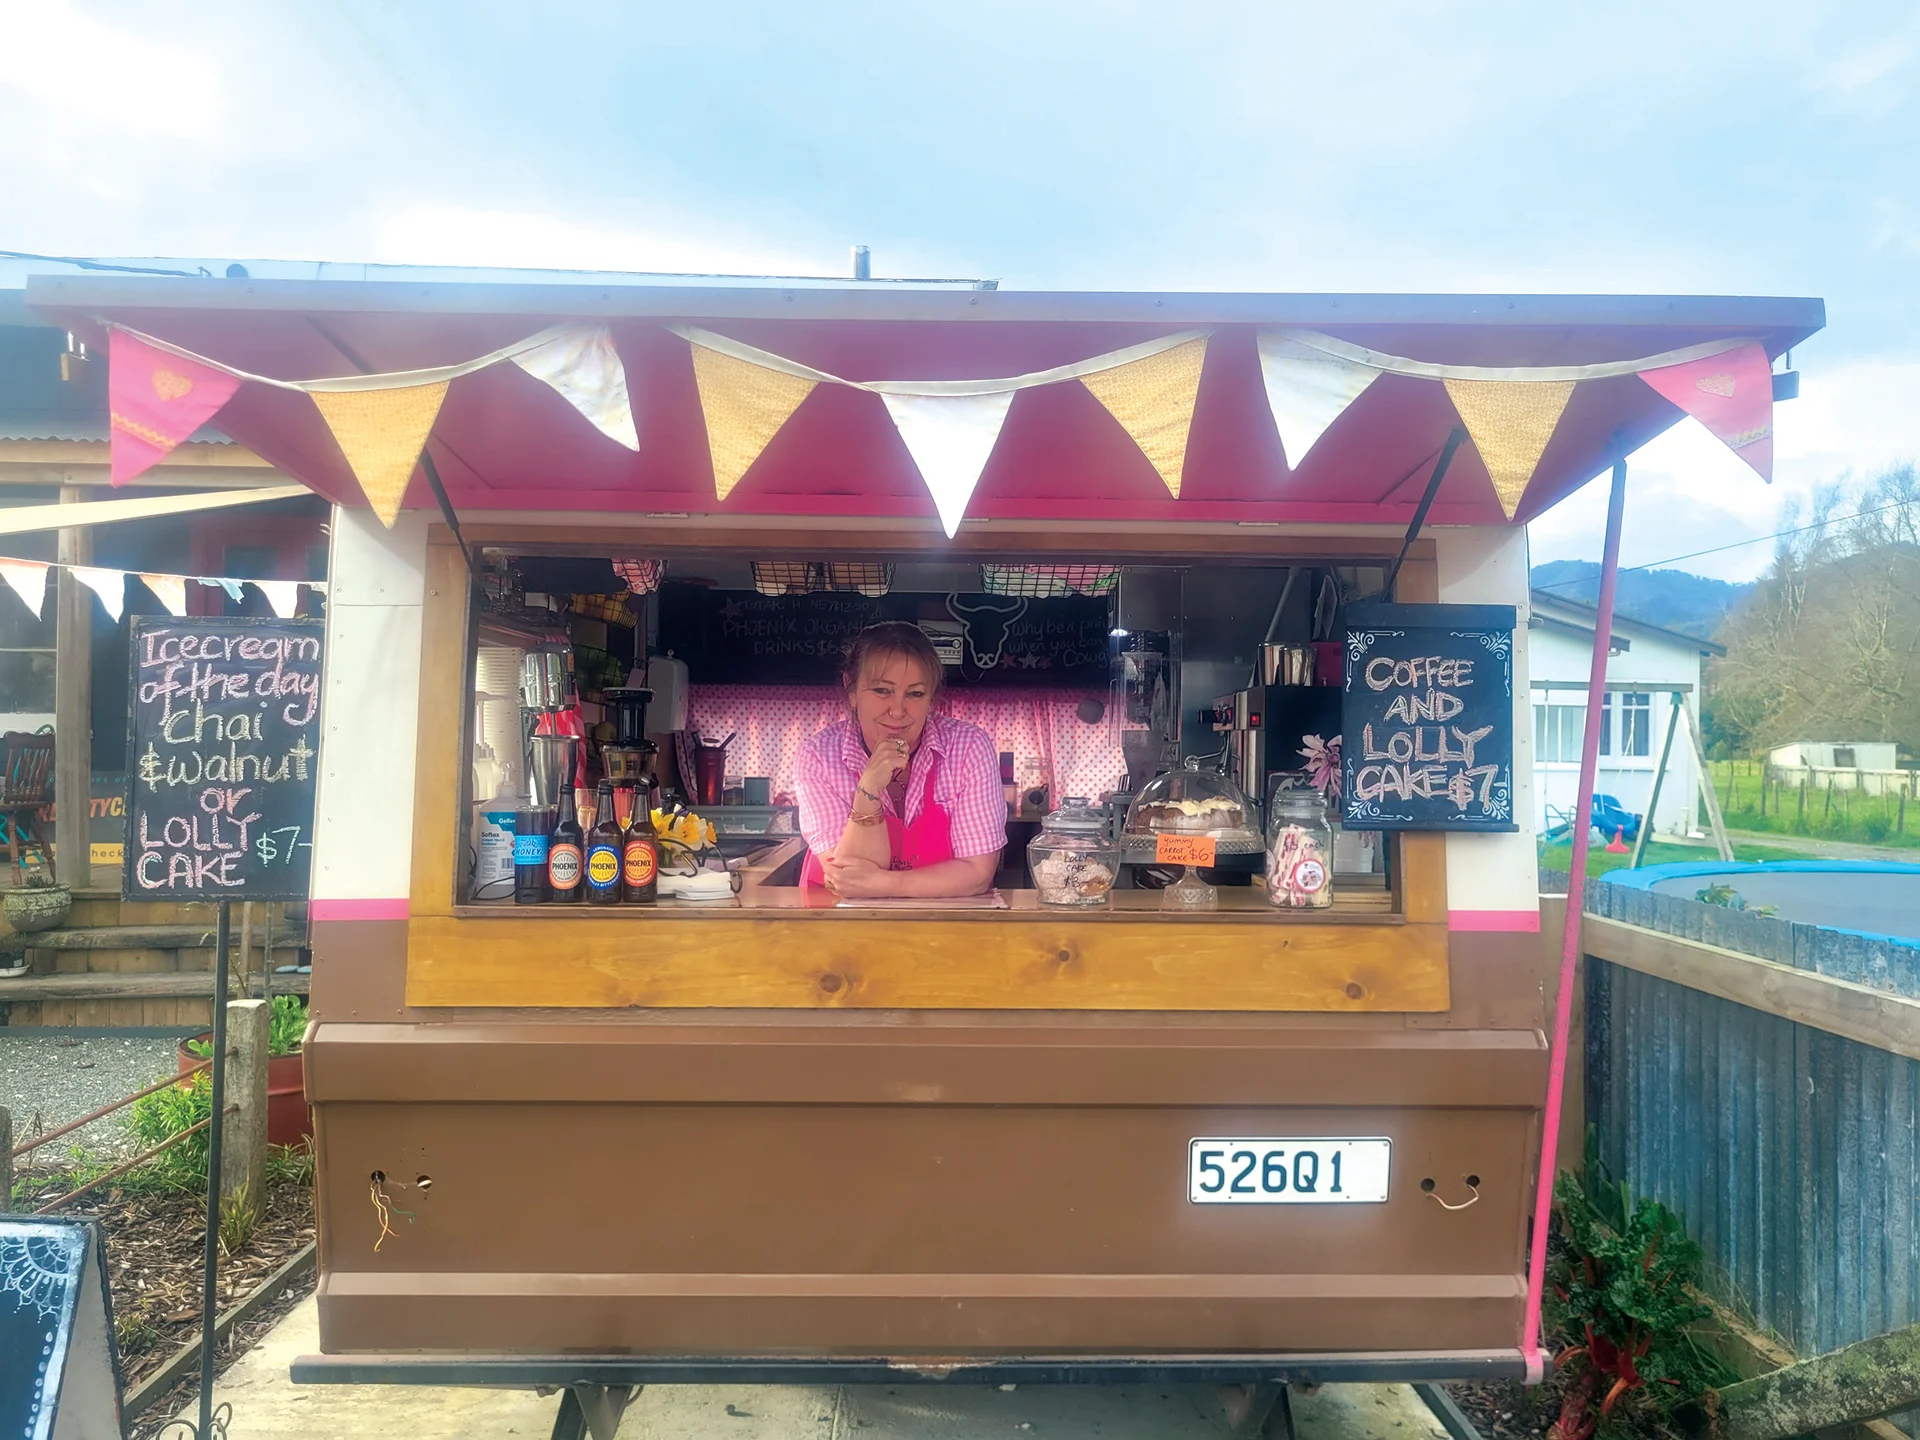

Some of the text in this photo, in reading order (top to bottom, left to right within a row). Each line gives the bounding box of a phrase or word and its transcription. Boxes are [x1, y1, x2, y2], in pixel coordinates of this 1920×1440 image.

[141, 629, 320, 667] Icecream
[1050, 641, 1076, 657] you
[139, 660, 185, 726] of
[255, 650, 320, 726] day
[163, 697, 264, 745] chai
[1383, 687, 1464, 726] AND
[1362, 722, 1494, 770] LOLLY
[1356, 763, 1450, 804] CAKE
[200, 787, 252, 815] or
[139, 810, 263, 851] LOLLY
[1163, 835, 1195, 849] yummy
[552, 862, 578, 870] PHOENIX
[590, 862, 617, 870] PHOENIX
[626, 859, 652, 867] PHOENIX
[1064, 853, 1090, 863] LOLLY
[1159, 846, 1186, 855] CARROT
[136, 851, 246, 889] CAKE
[1066, 864, 1088, 872] CAKE
[1199, 1150, 1343, 1193] 526Q1
